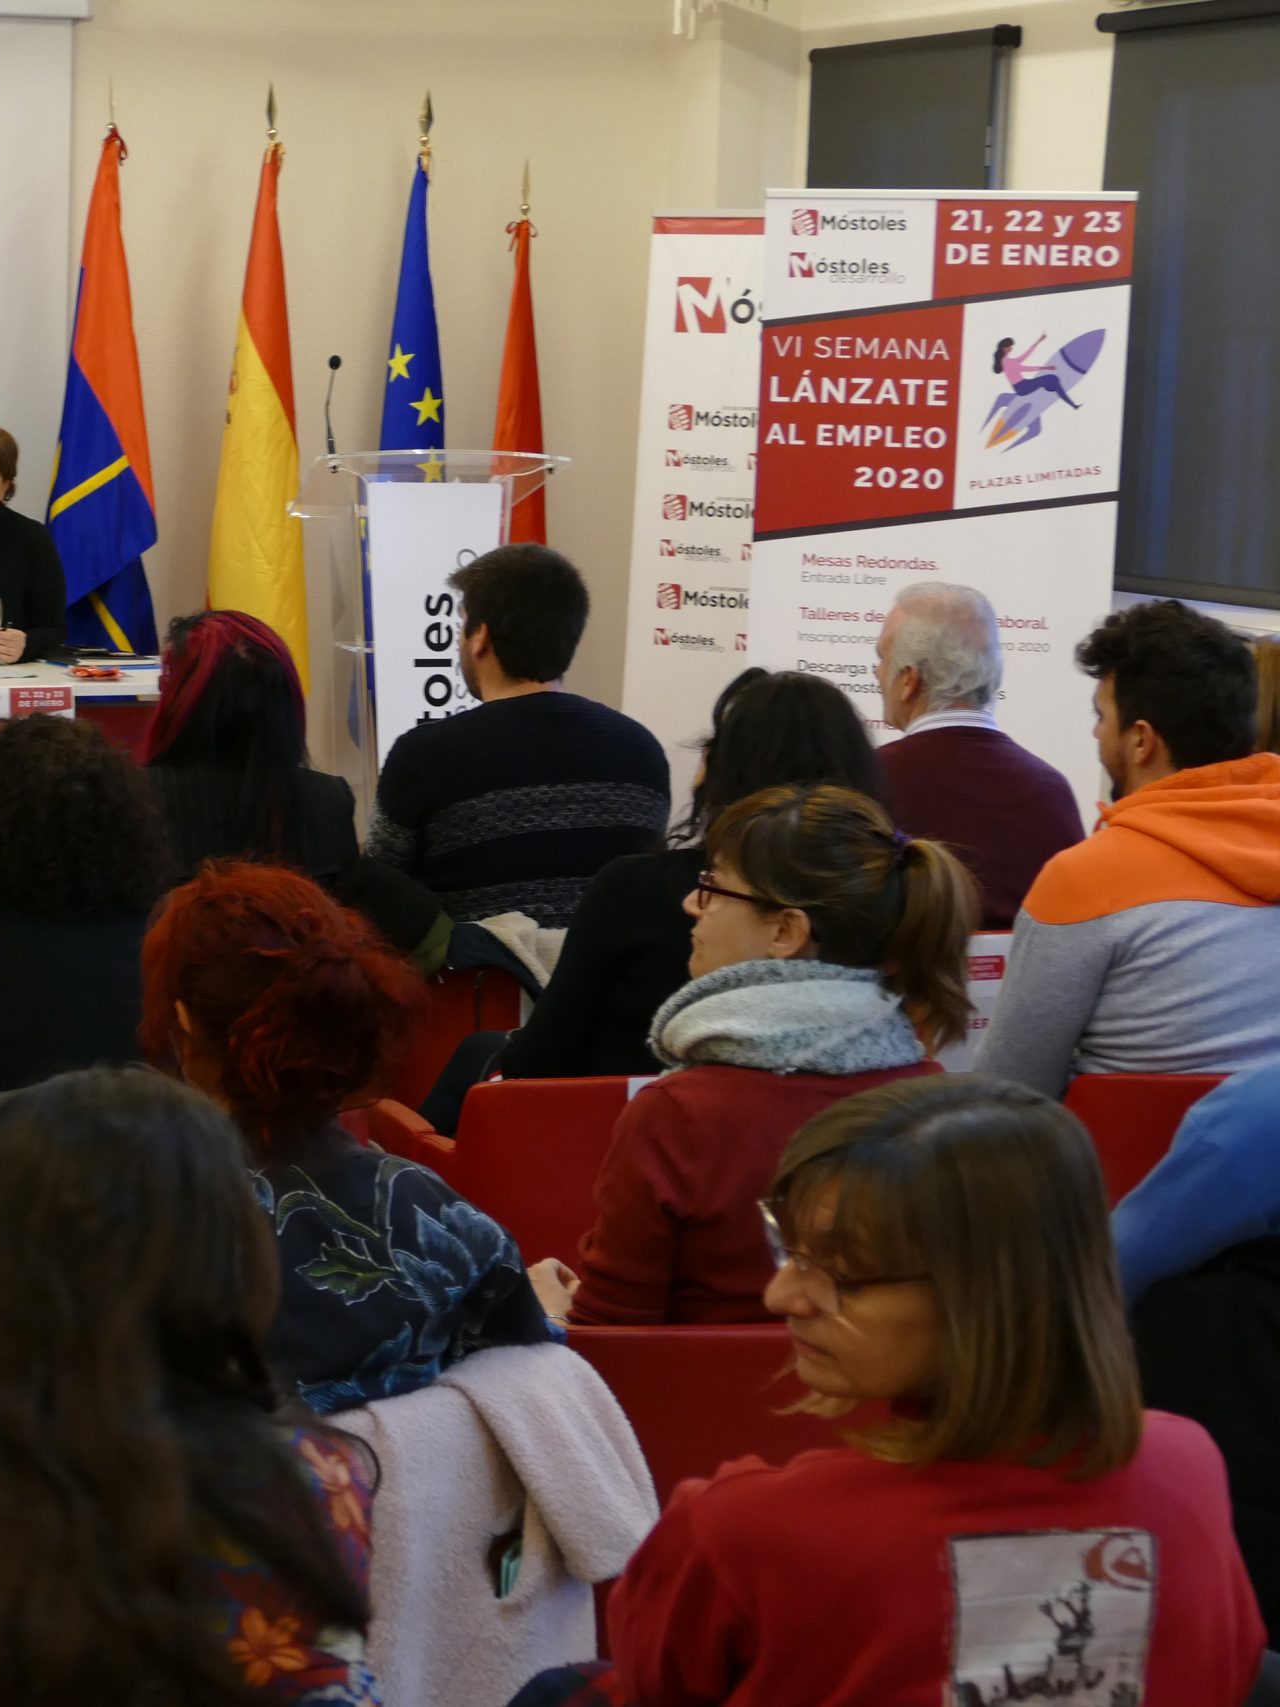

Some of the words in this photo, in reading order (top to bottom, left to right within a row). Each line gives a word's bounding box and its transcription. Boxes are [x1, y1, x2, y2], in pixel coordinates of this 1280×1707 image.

[820, 213, 908, 232] Móstoles
[949, 209, 994, 235] 21,
[1004, 209, 1045, 233] 22
[1053, 214, 1074, 238] y
[1083, 210, 1123, 234] 23
[788, 251, 891, 279] Móstoles
[945, 243, 991, 266] DE
[1001, 243, 1121, 268] ENERO
[771, 334, 802, 359] VI
[813, 336, 951, 362] SEMANA
[769, 368, 949, 407] LÁNZATE
[694, 410, 756, 429] Móstol
[764, 422, 806, 446] AL
[815, 424, 947, 450] EMPLEO
[852, 465, 945, 490] 2020
[968, 474, 1023, 491] PLAZAS
[1026, 464, 1103, 485] LIMITADAS
[801, 553, 853, 568] Mesas
[856, 554, 940, 572] Redondas.
[801, 571, 851, 585] Entrada
[853, 572, 888, 586] Libre
[799, 606, 860, 622] Talleres
[864, 609, 886, 623] de
[1018, 642, 1052, 653] 2020
[797, 658, 868, 678] Descarga
